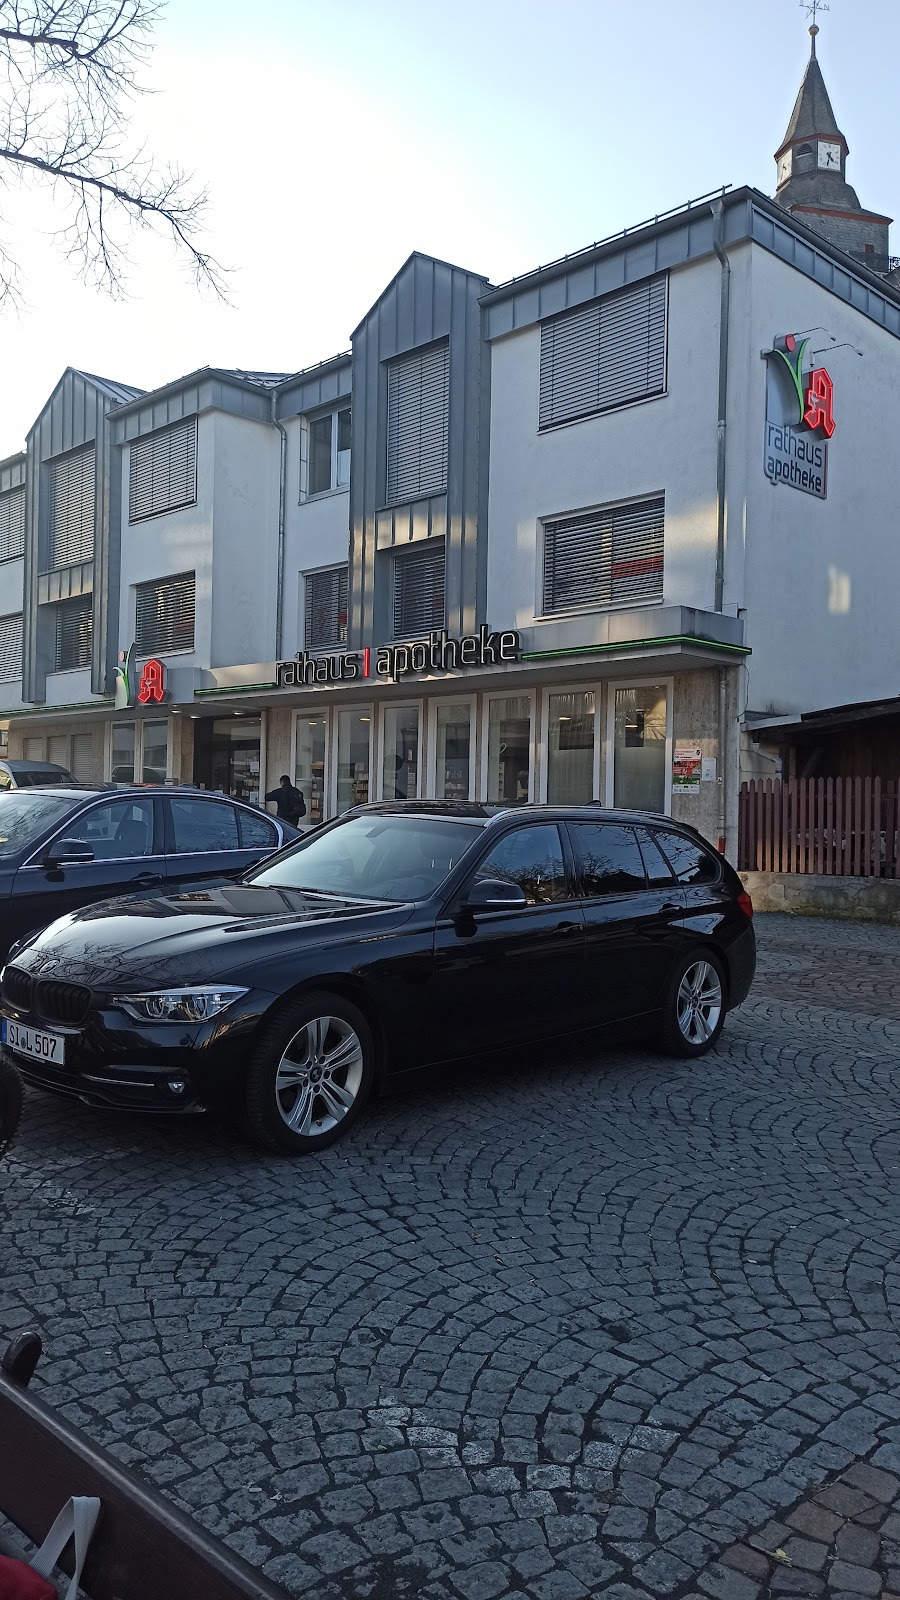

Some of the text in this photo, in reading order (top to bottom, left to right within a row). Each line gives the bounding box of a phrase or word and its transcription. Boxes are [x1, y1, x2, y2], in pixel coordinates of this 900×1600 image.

[767, 424, 823, 468] rathaus
[767, 456, 822, 493] apotheke
[275, 624, 523, 687] rathaus apotheke
[35, 1034, 56, 1058] 507
